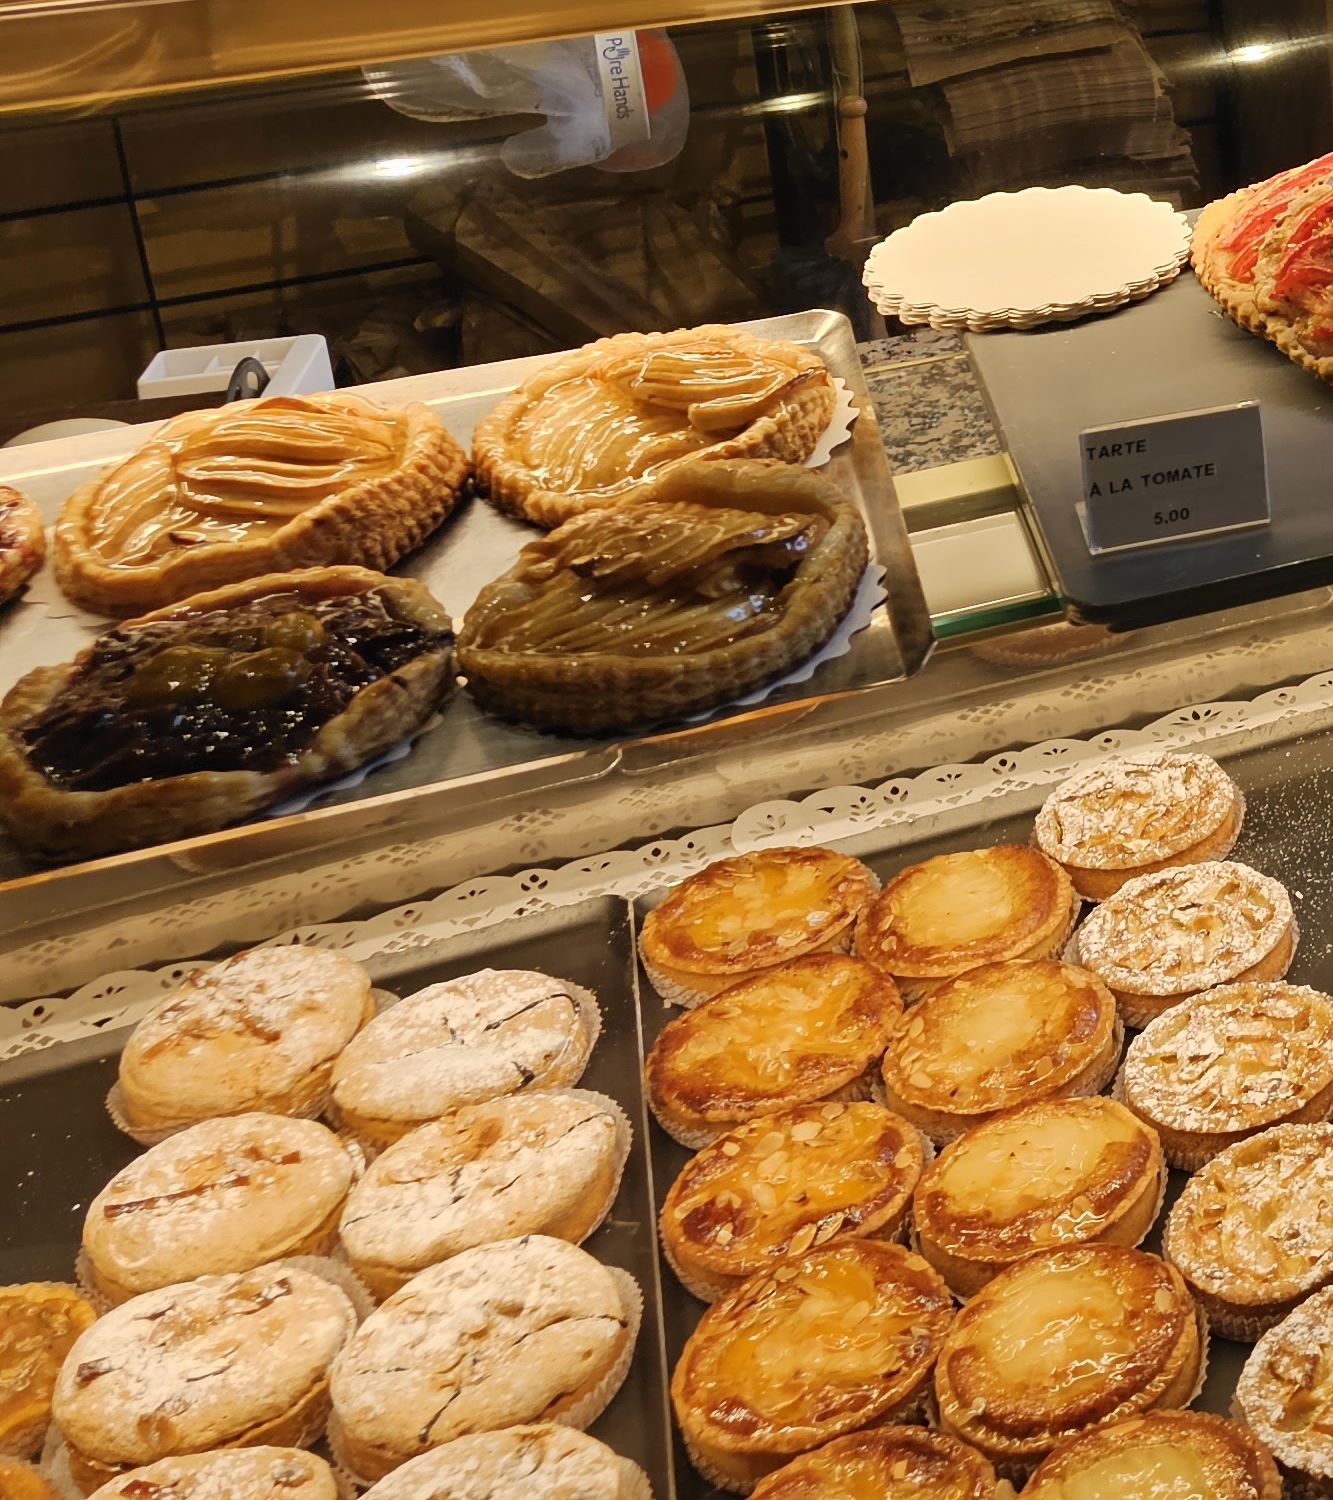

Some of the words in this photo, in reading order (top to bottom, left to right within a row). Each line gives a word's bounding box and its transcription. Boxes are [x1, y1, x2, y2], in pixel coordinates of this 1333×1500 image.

[612, 76, 634, 120] Hands
[1086, 439, 1147, 461] TARTE
[1109, 478, 1132, 495] LA
[1141, 463, 1215, 488] TOMATE
